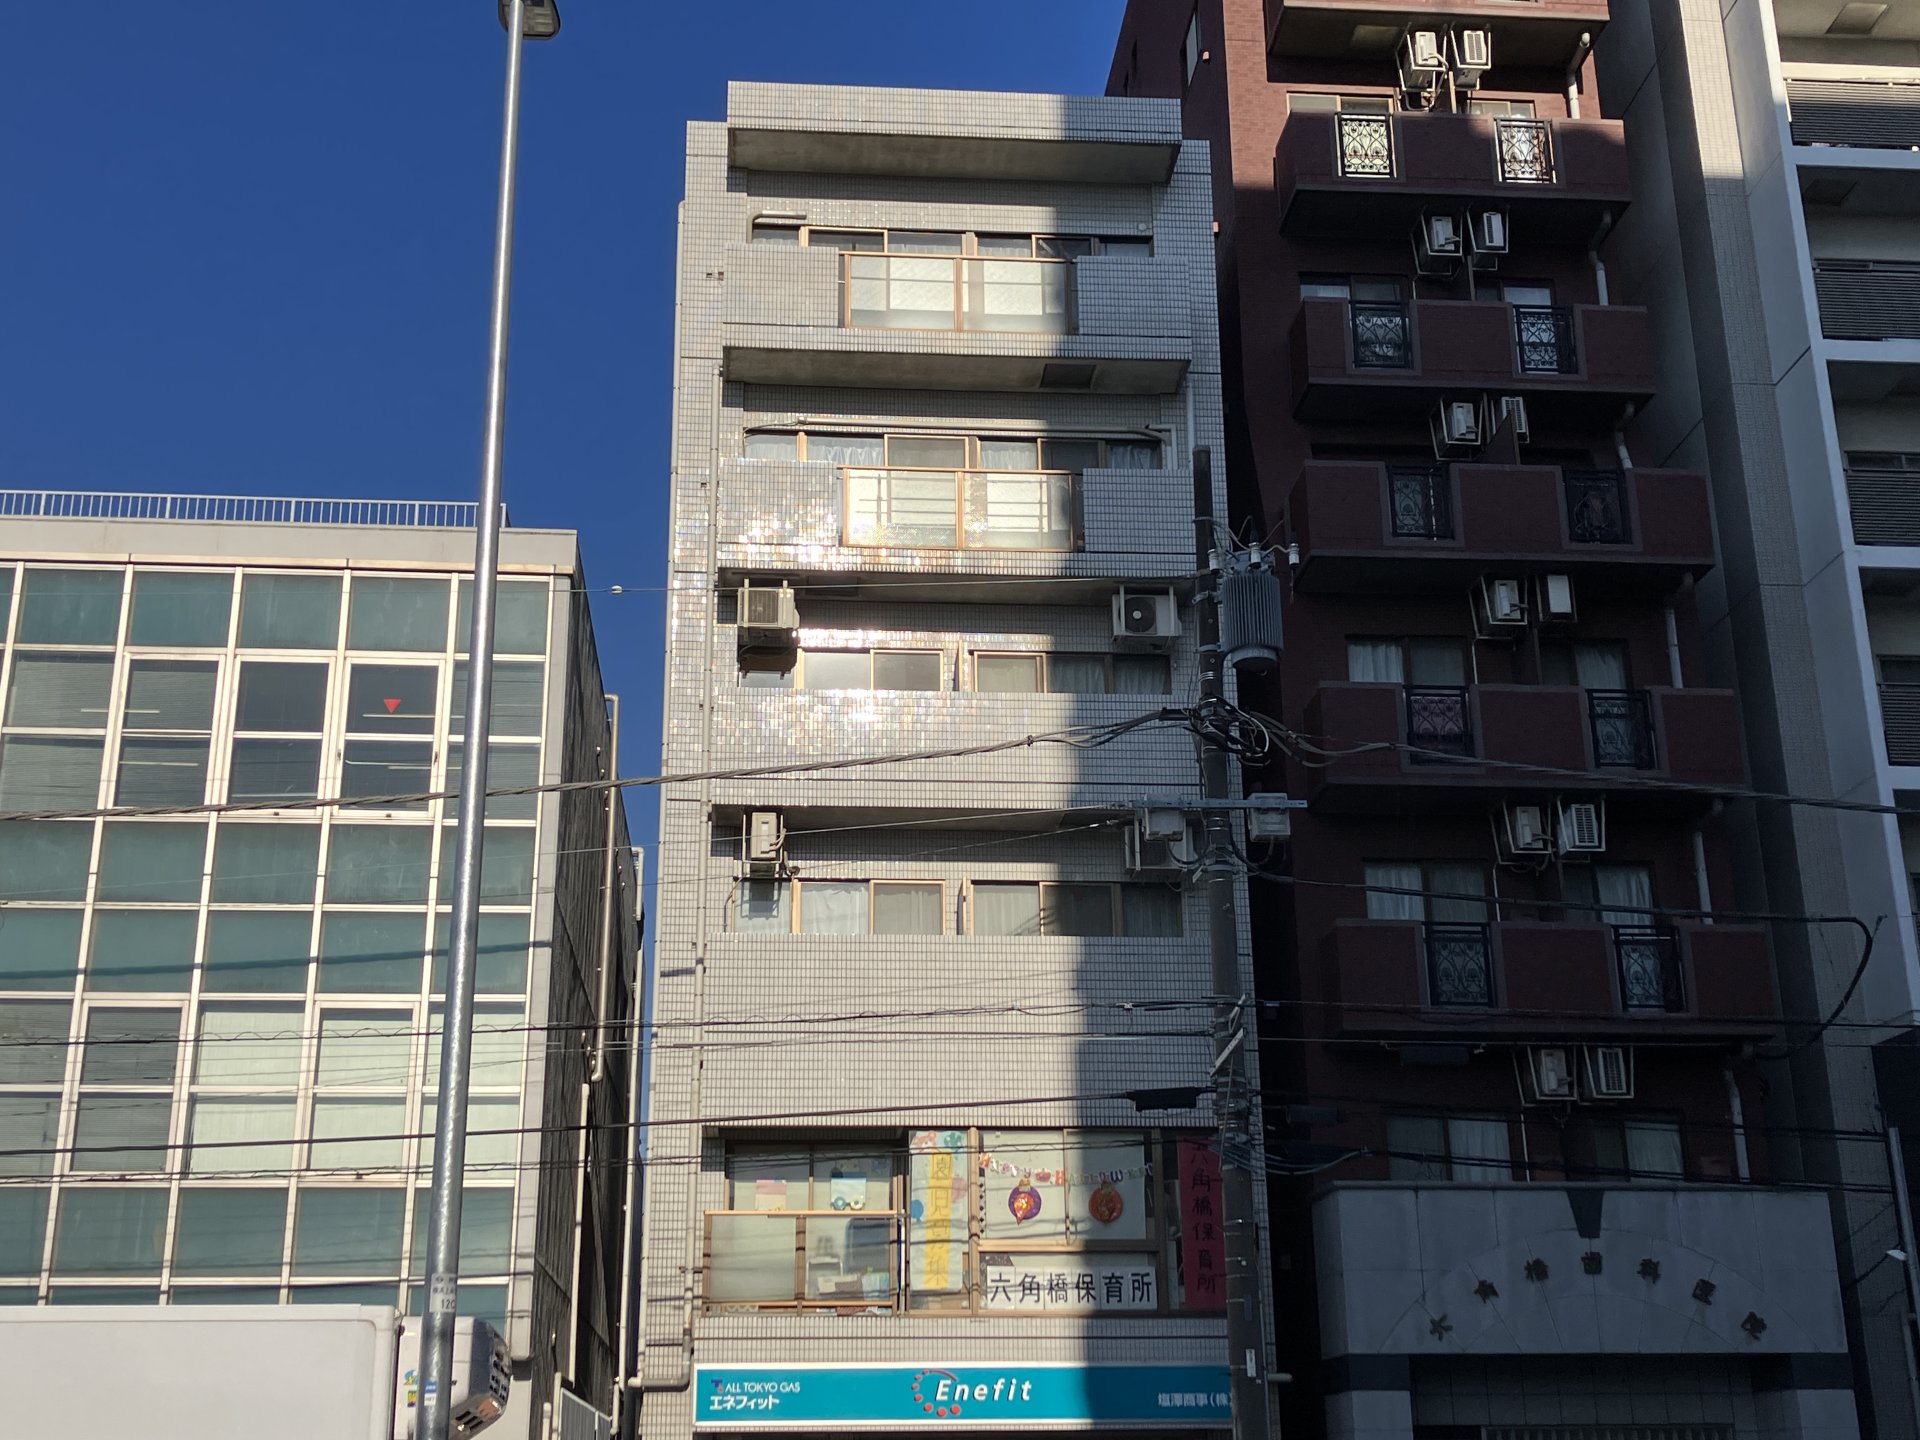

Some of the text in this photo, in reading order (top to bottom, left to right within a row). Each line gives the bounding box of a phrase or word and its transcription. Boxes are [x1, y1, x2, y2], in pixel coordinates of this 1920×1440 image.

[990, 1271, 1153, 1304] 六角橋保育所
[725, 1382, 801, 1393] ALL TOKYO GAS
[935, 1378, 1032, 1401] Enefit
[709, 1394, 780, 1410] エネフィット
